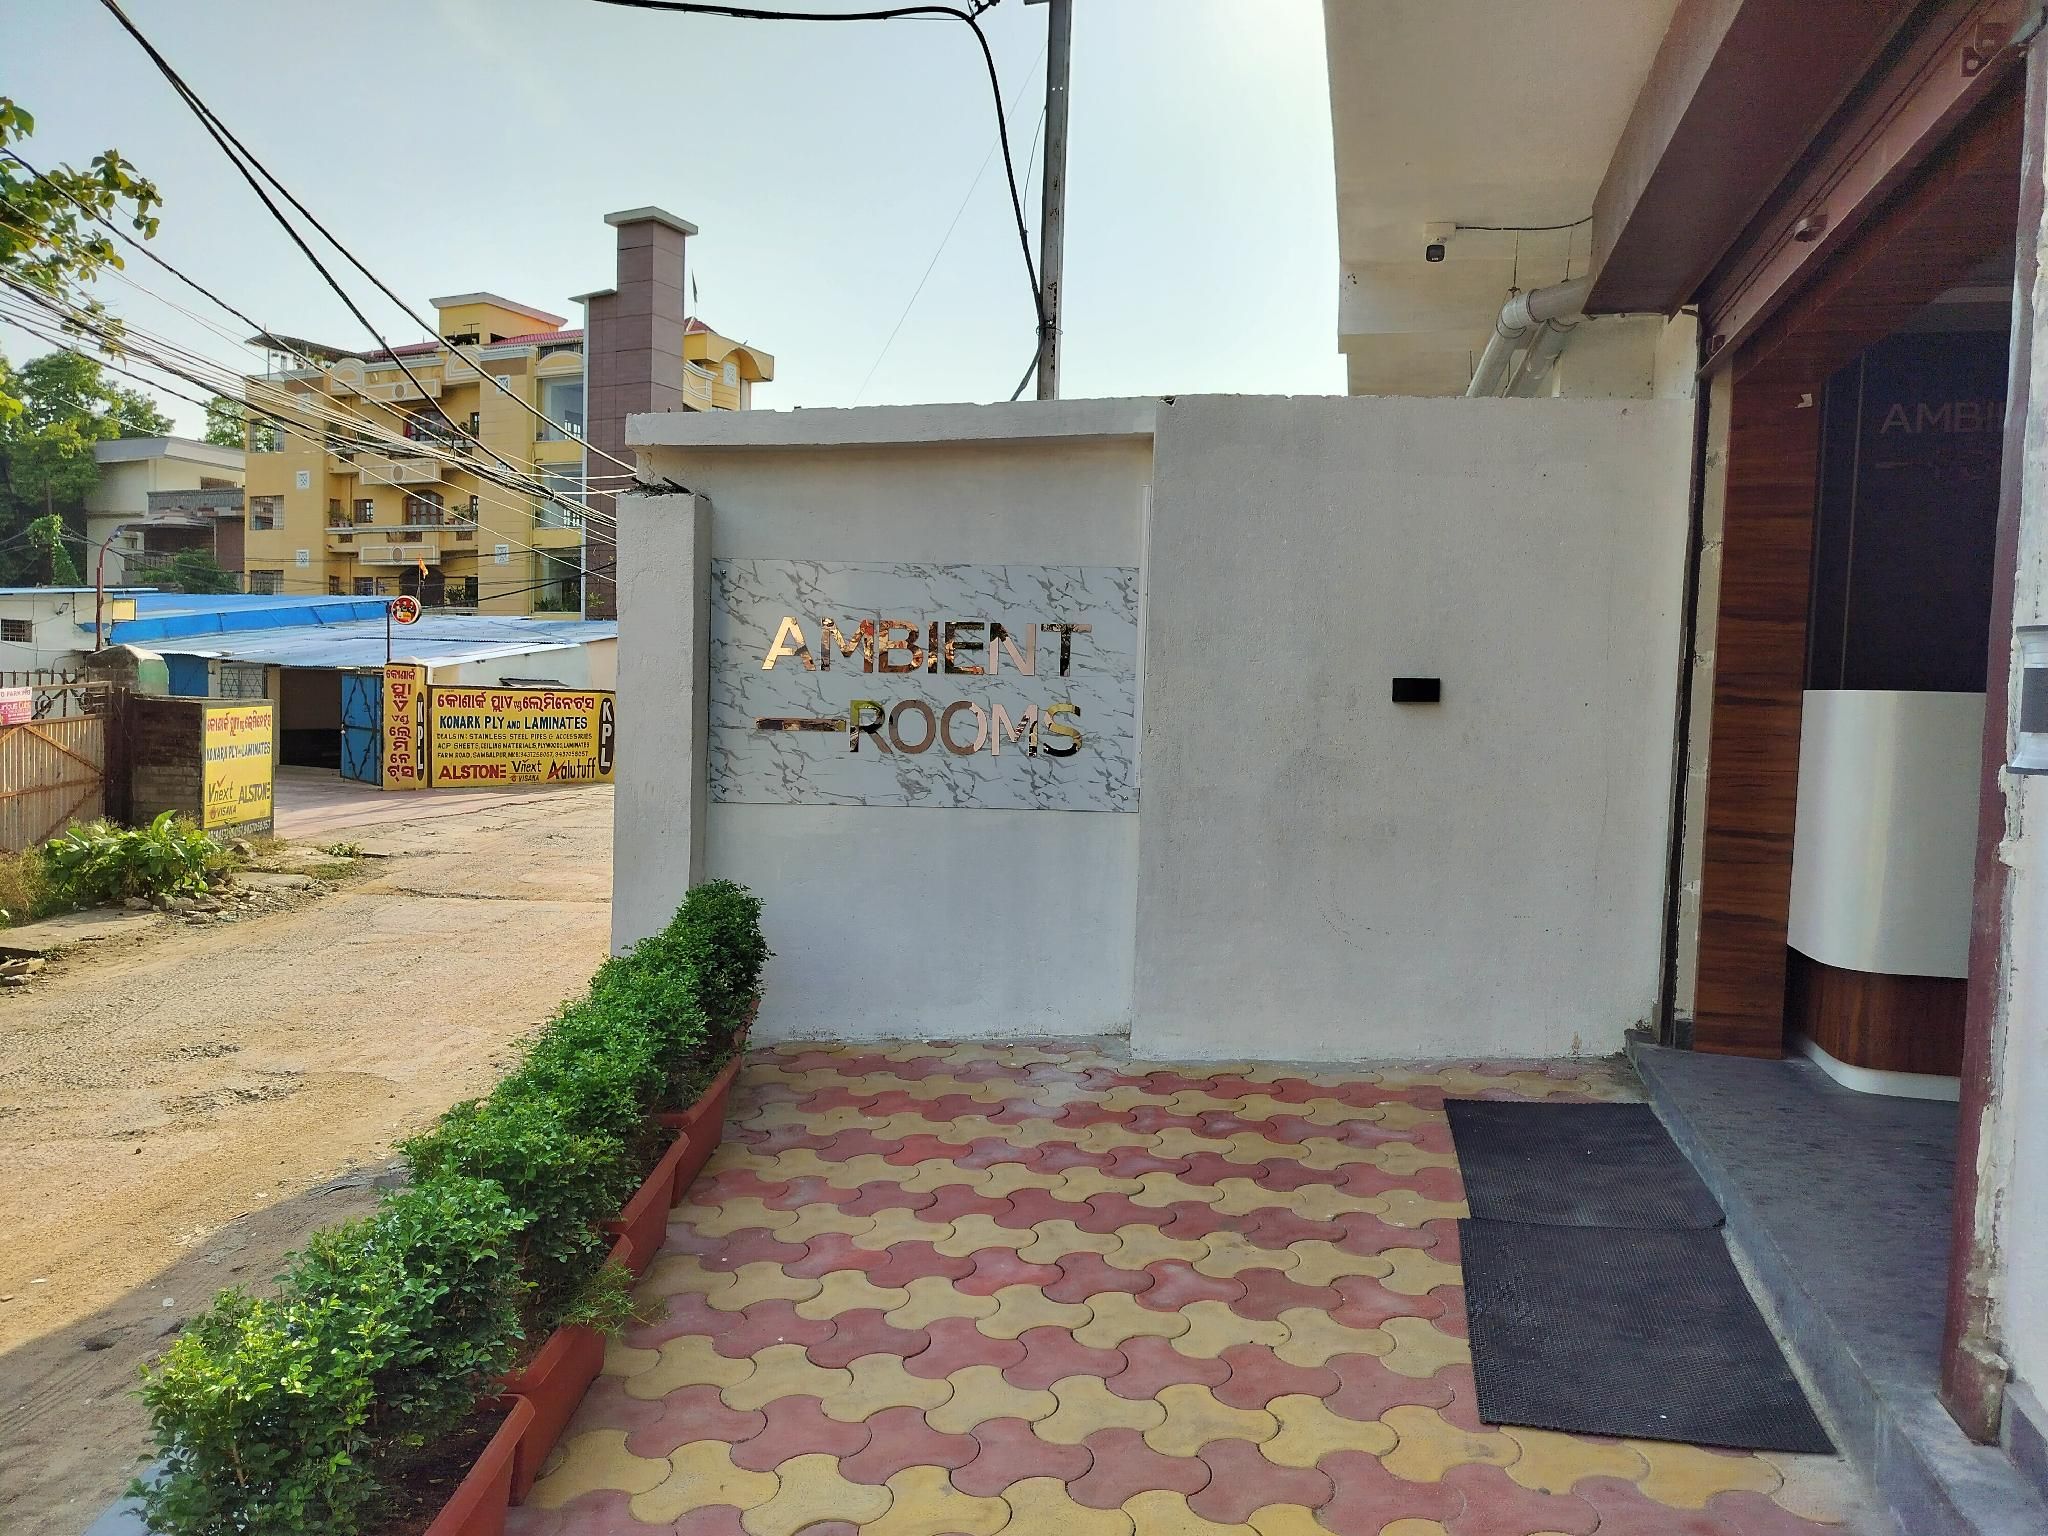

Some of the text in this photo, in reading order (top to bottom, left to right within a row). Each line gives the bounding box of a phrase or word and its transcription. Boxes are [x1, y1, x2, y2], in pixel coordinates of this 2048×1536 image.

[761, 616, 1092, 677] AMBIENT
[439, 716, 588, 729] KONARK PLY AND LAMINATES
[850, 699, 1083, 758] ROOMS
[438, 765, 506, 780] ALSTONE
